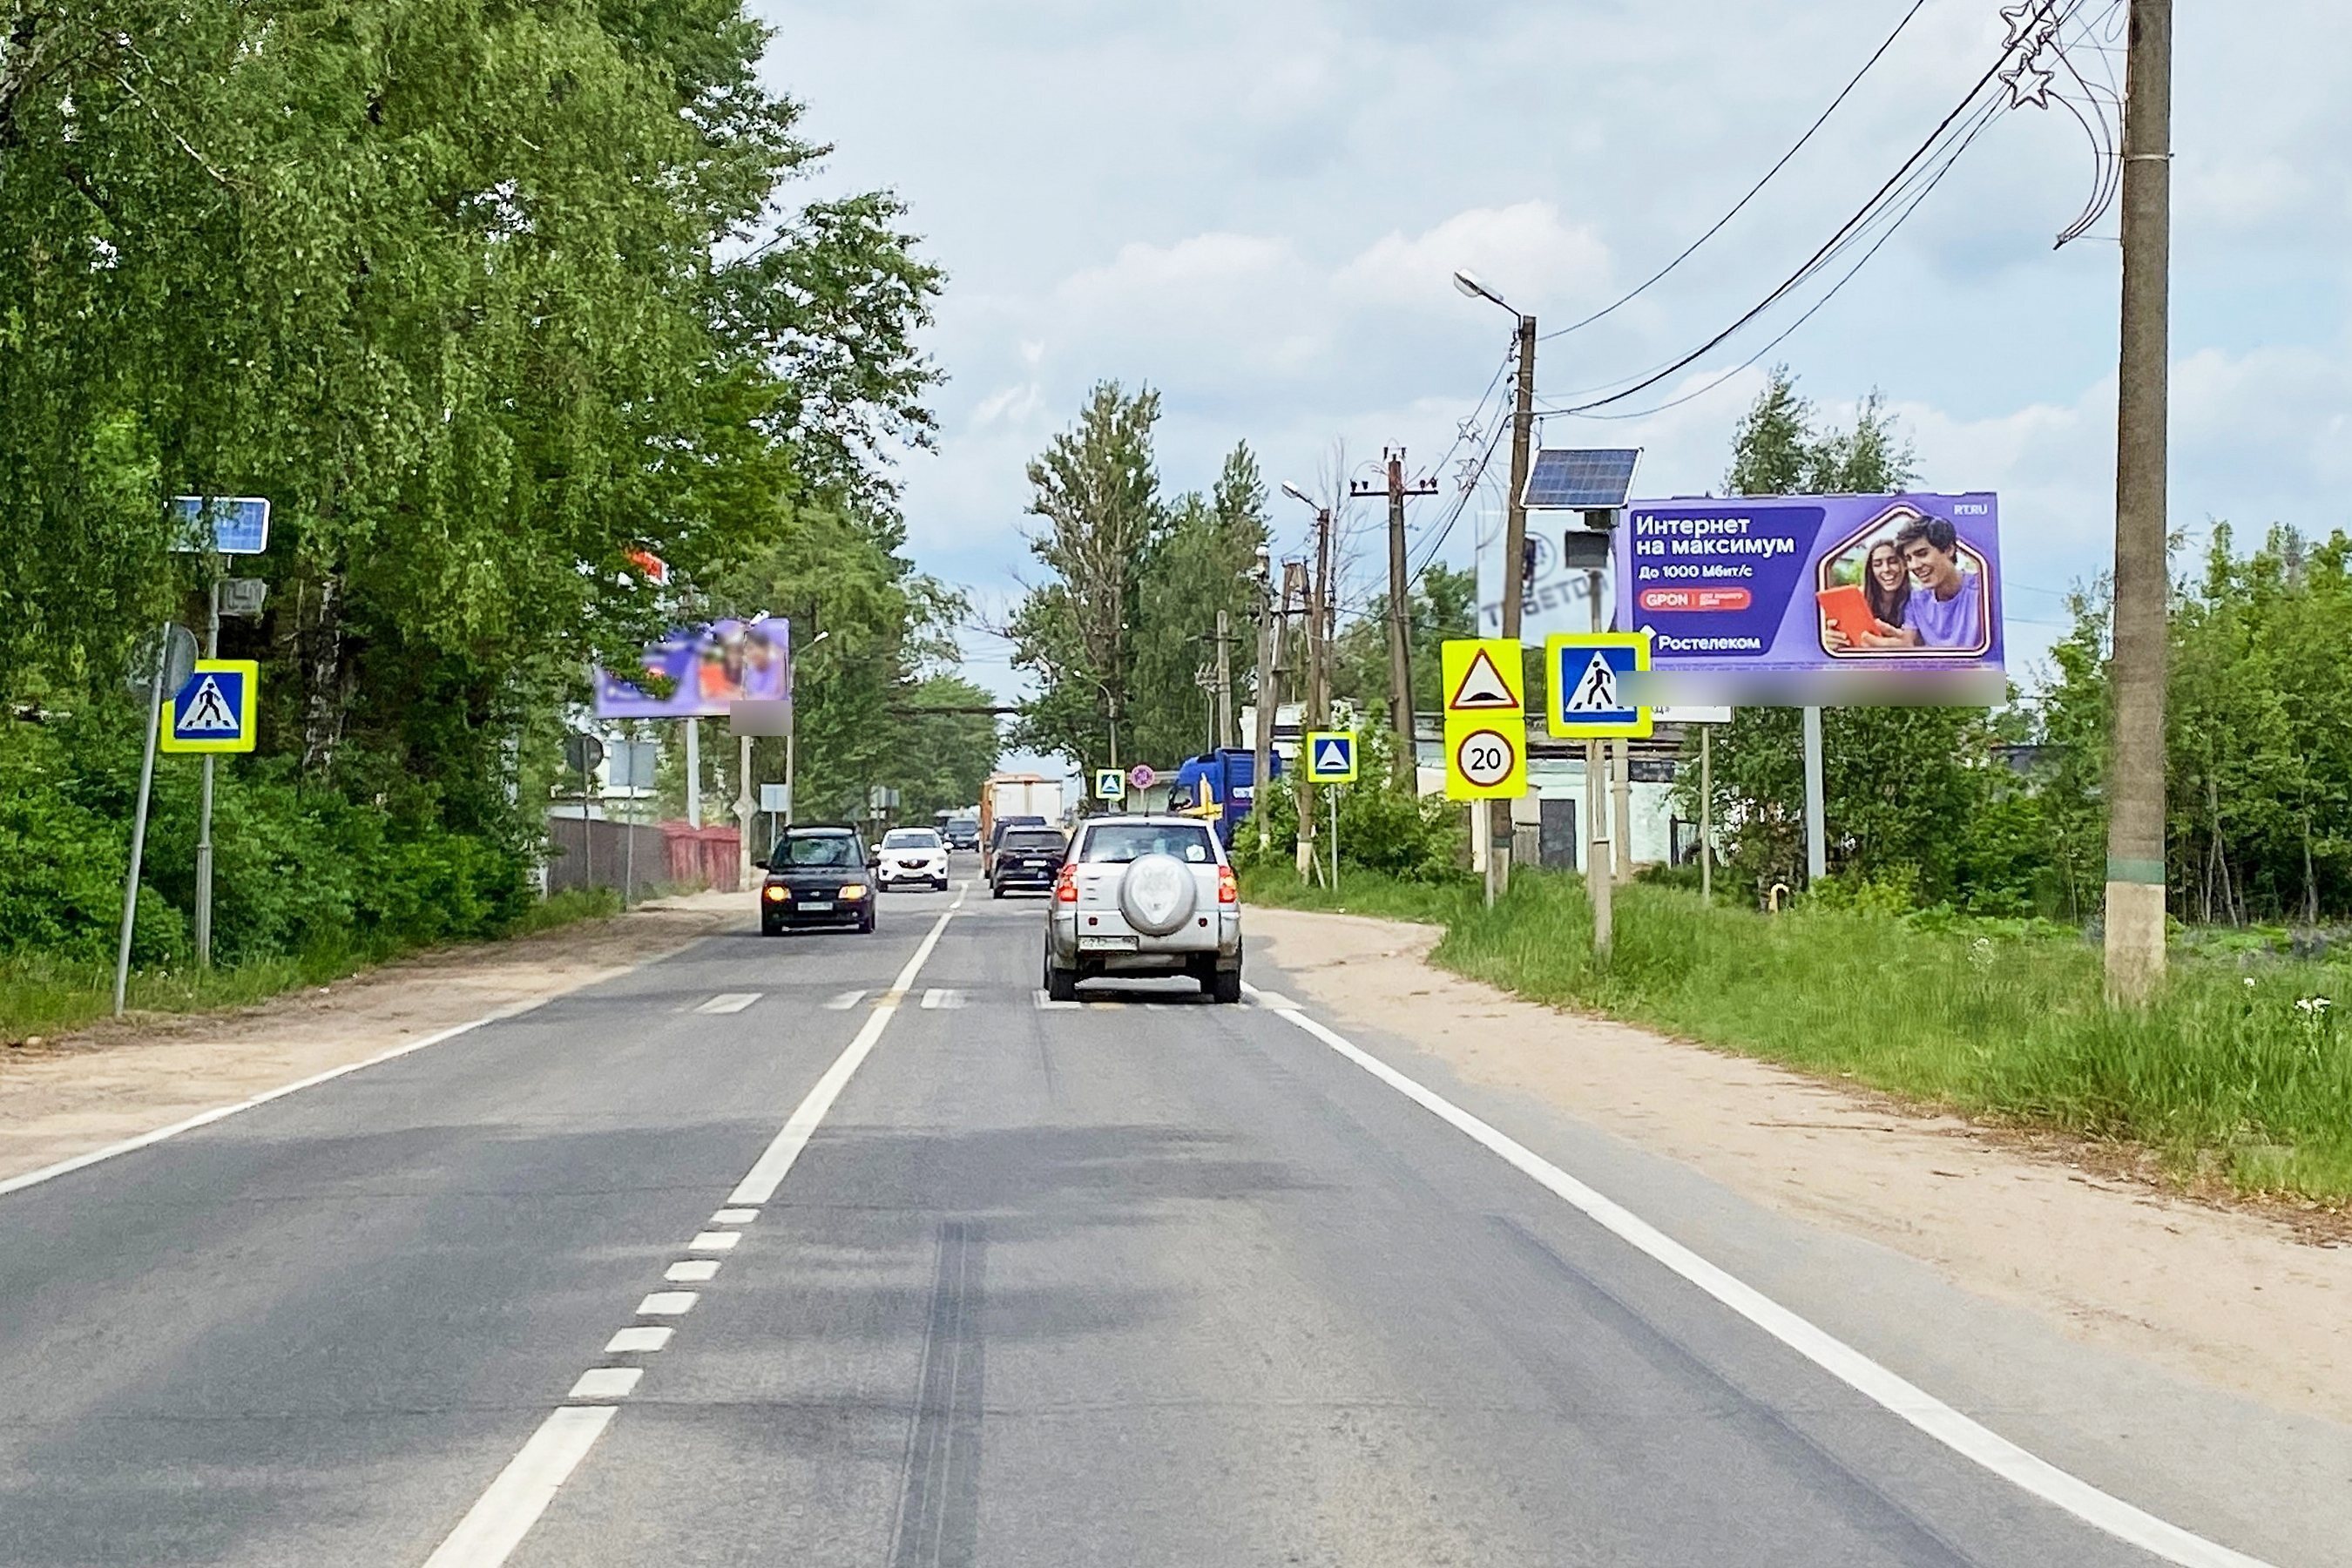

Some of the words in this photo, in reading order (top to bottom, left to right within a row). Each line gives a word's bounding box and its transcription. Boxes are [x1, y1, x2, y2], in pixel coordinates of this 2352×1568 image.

[1636, 515, 1750, 538] Интернет
[1637, 539, 1665, 555] на
[1672, 537, 1794, 558] максимум
[1639, 566, 1659, 579] До
[1662, 565, 1699, 578] 1000
[1702, 564, 1753, 578] Мбит/с
[1646, 593, 1688, 606] GPON
[1658, 635, 1761, 650] Ростелеком
[1470, 747, 1501, 770] 20
